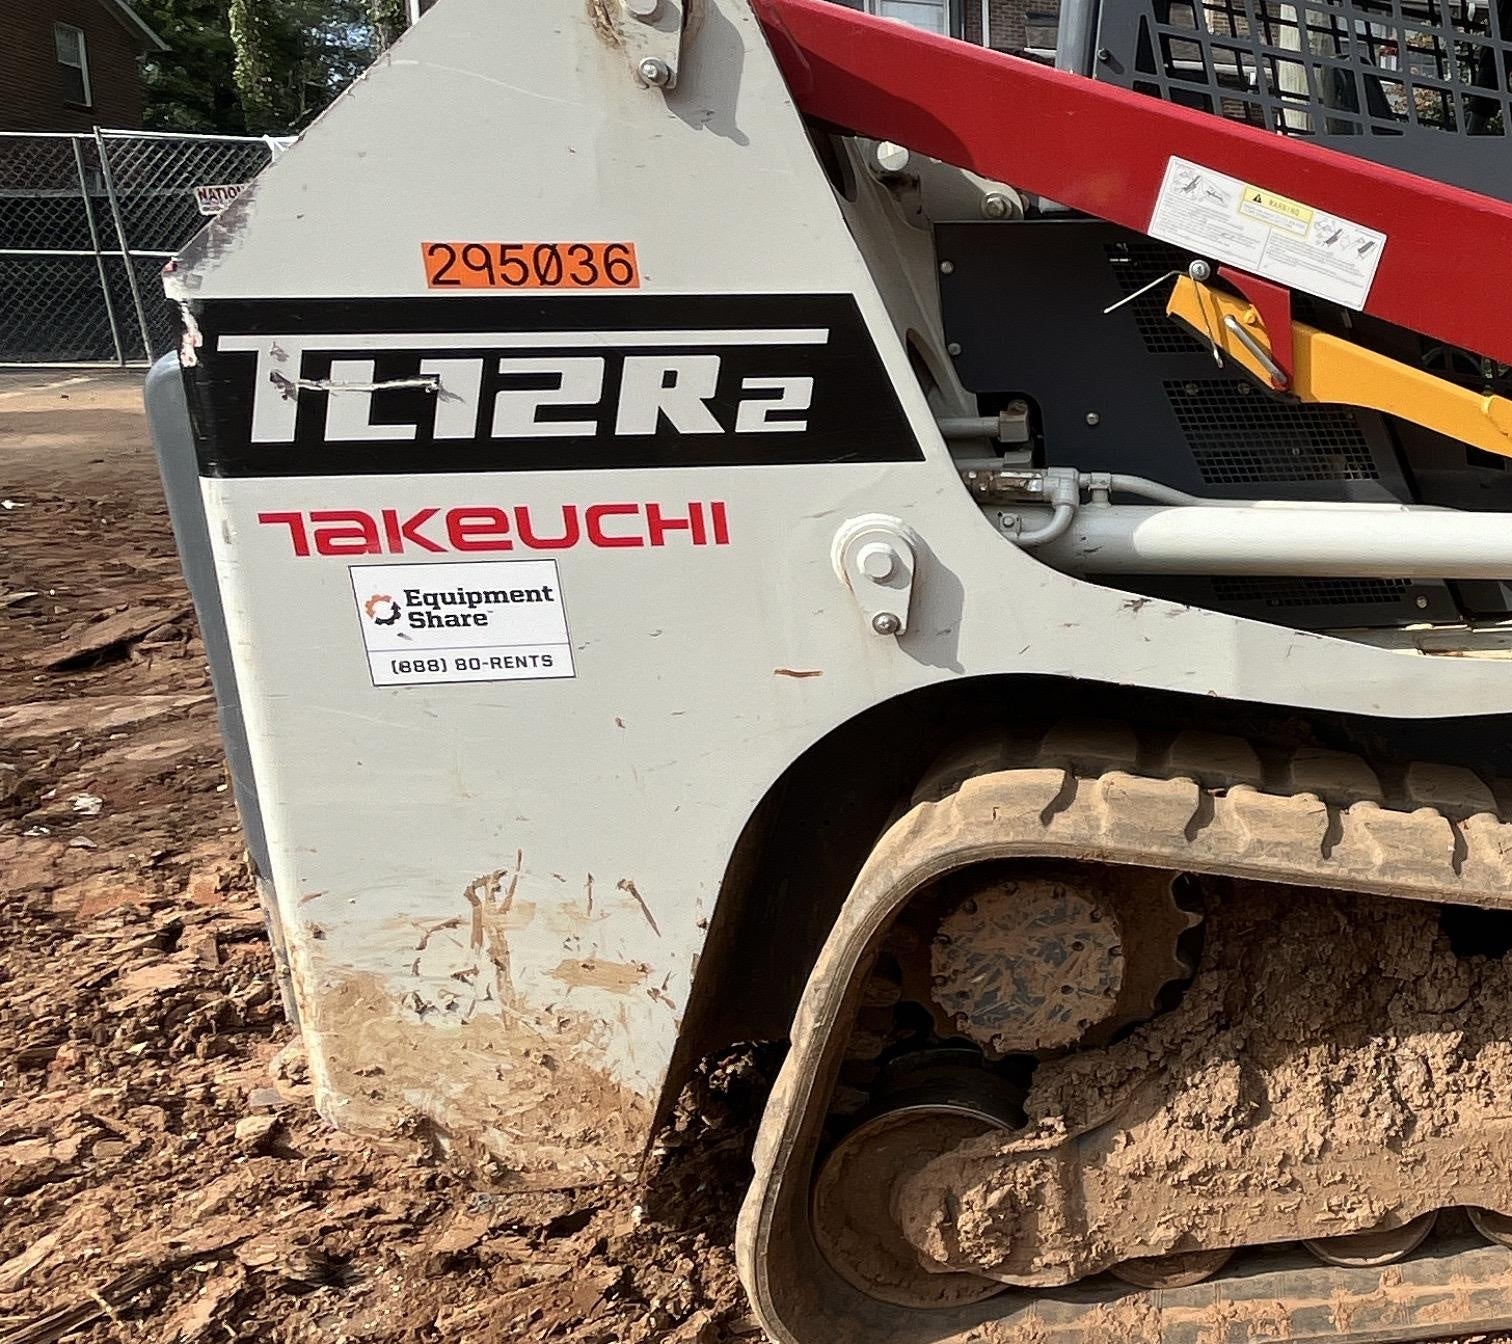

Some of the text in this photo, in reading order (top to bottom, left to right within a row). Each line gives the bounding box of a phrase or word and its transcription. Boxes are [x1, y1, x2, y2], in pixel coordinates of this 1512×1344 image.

[428, 243, 634, 286] 295036
[403, 585, 555, 610] Equipment
[407, 611, 489, 629] Share
[391, 654, 554, 674] (888) 80-RENTS
